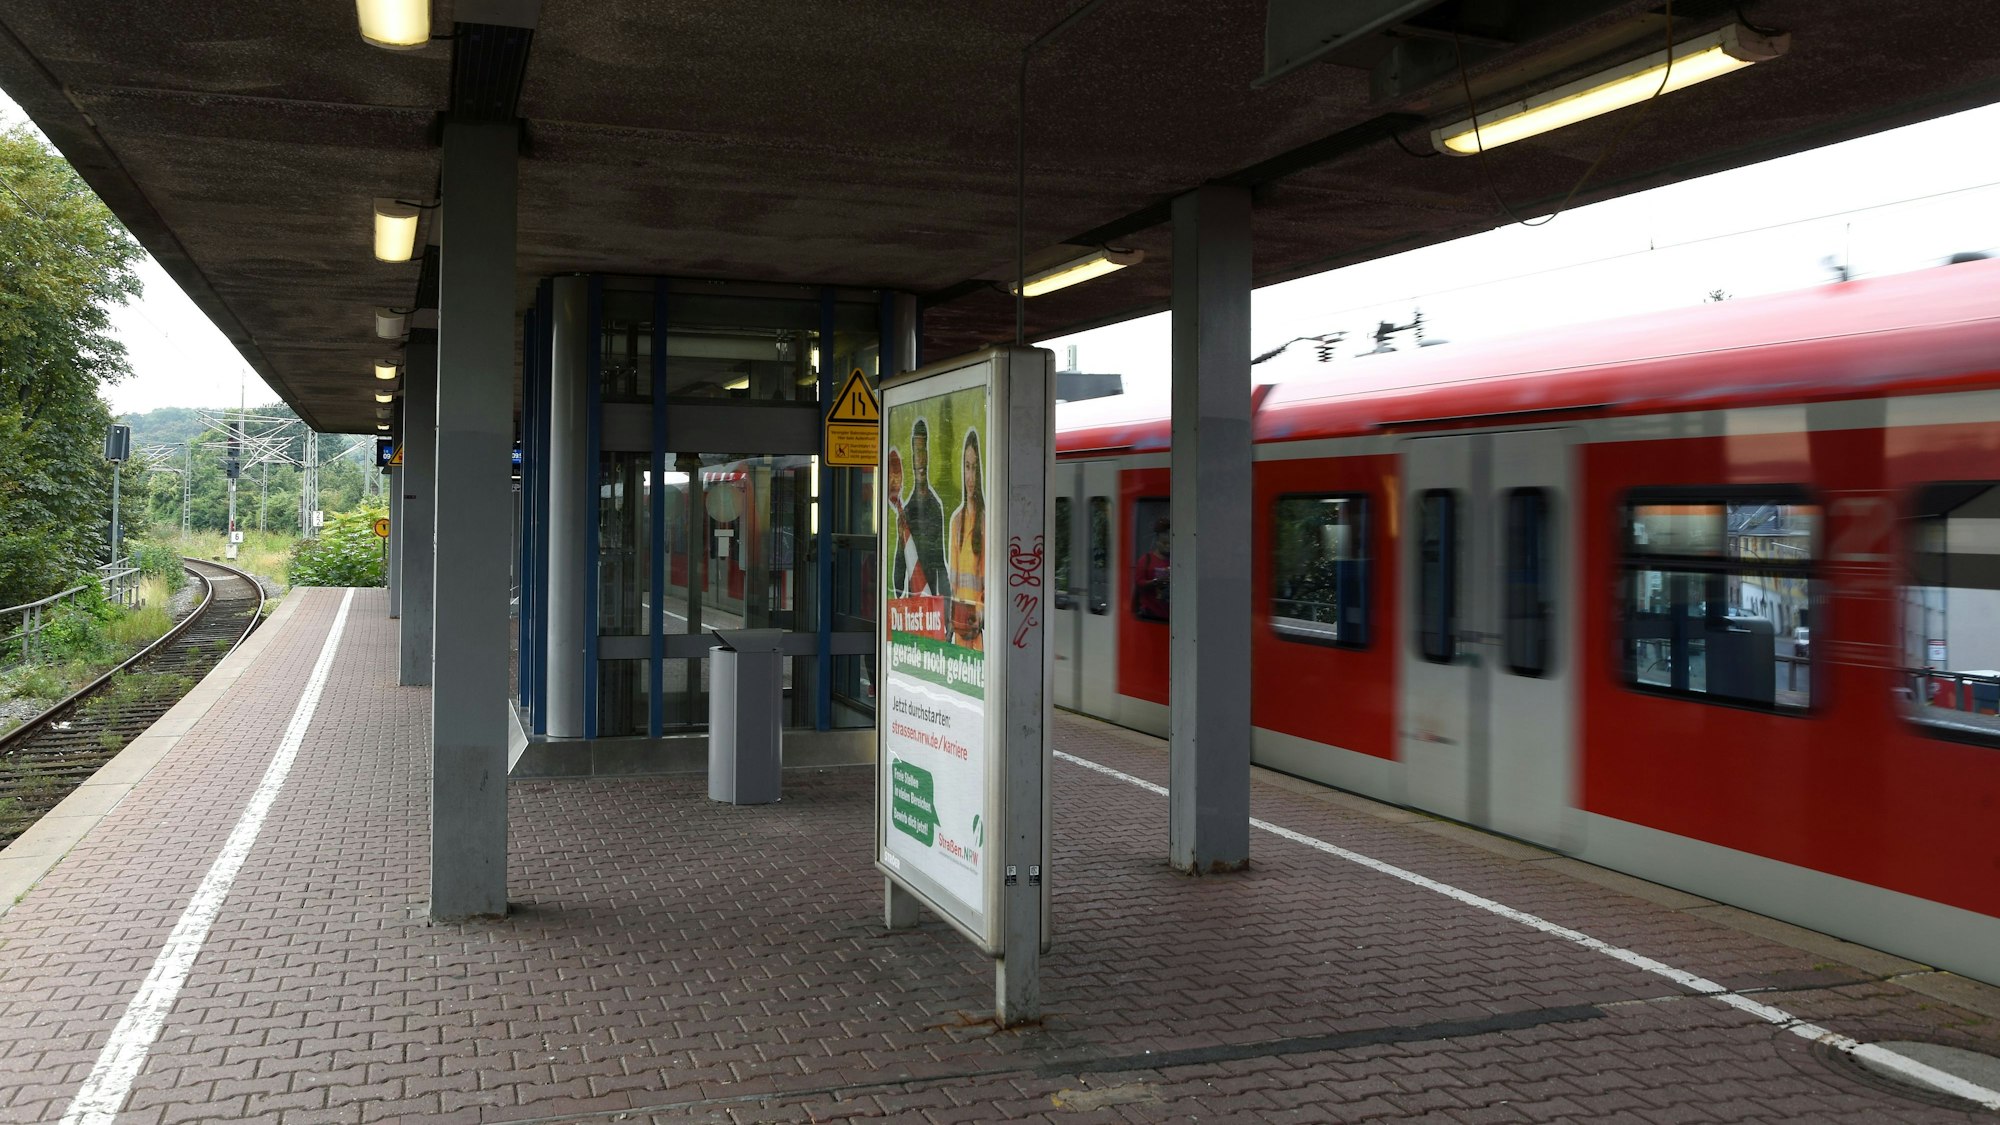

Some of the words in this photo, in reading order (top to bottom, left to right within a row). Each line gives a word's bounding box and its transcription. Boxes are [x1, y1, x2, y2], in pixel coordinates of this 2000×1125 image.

[235, 532, 239, 540] 6
[891, 607, 903, 631] Du
[905, 606, 924, 631] hast
[926, 611, 941, 631] uns
[892, 642, 922, 668] gerade
[923, 648, 946, 676] noch
[947, 654, 984, 689] gefehlt!
[892, 695, 907, 714] Jetzt
[908, 700, 951, 728] durchstarten:
[892, 719, 968, 761] strassen.nrw.de/karriere
[938, 832, 979, 867] Straßen.NRW
